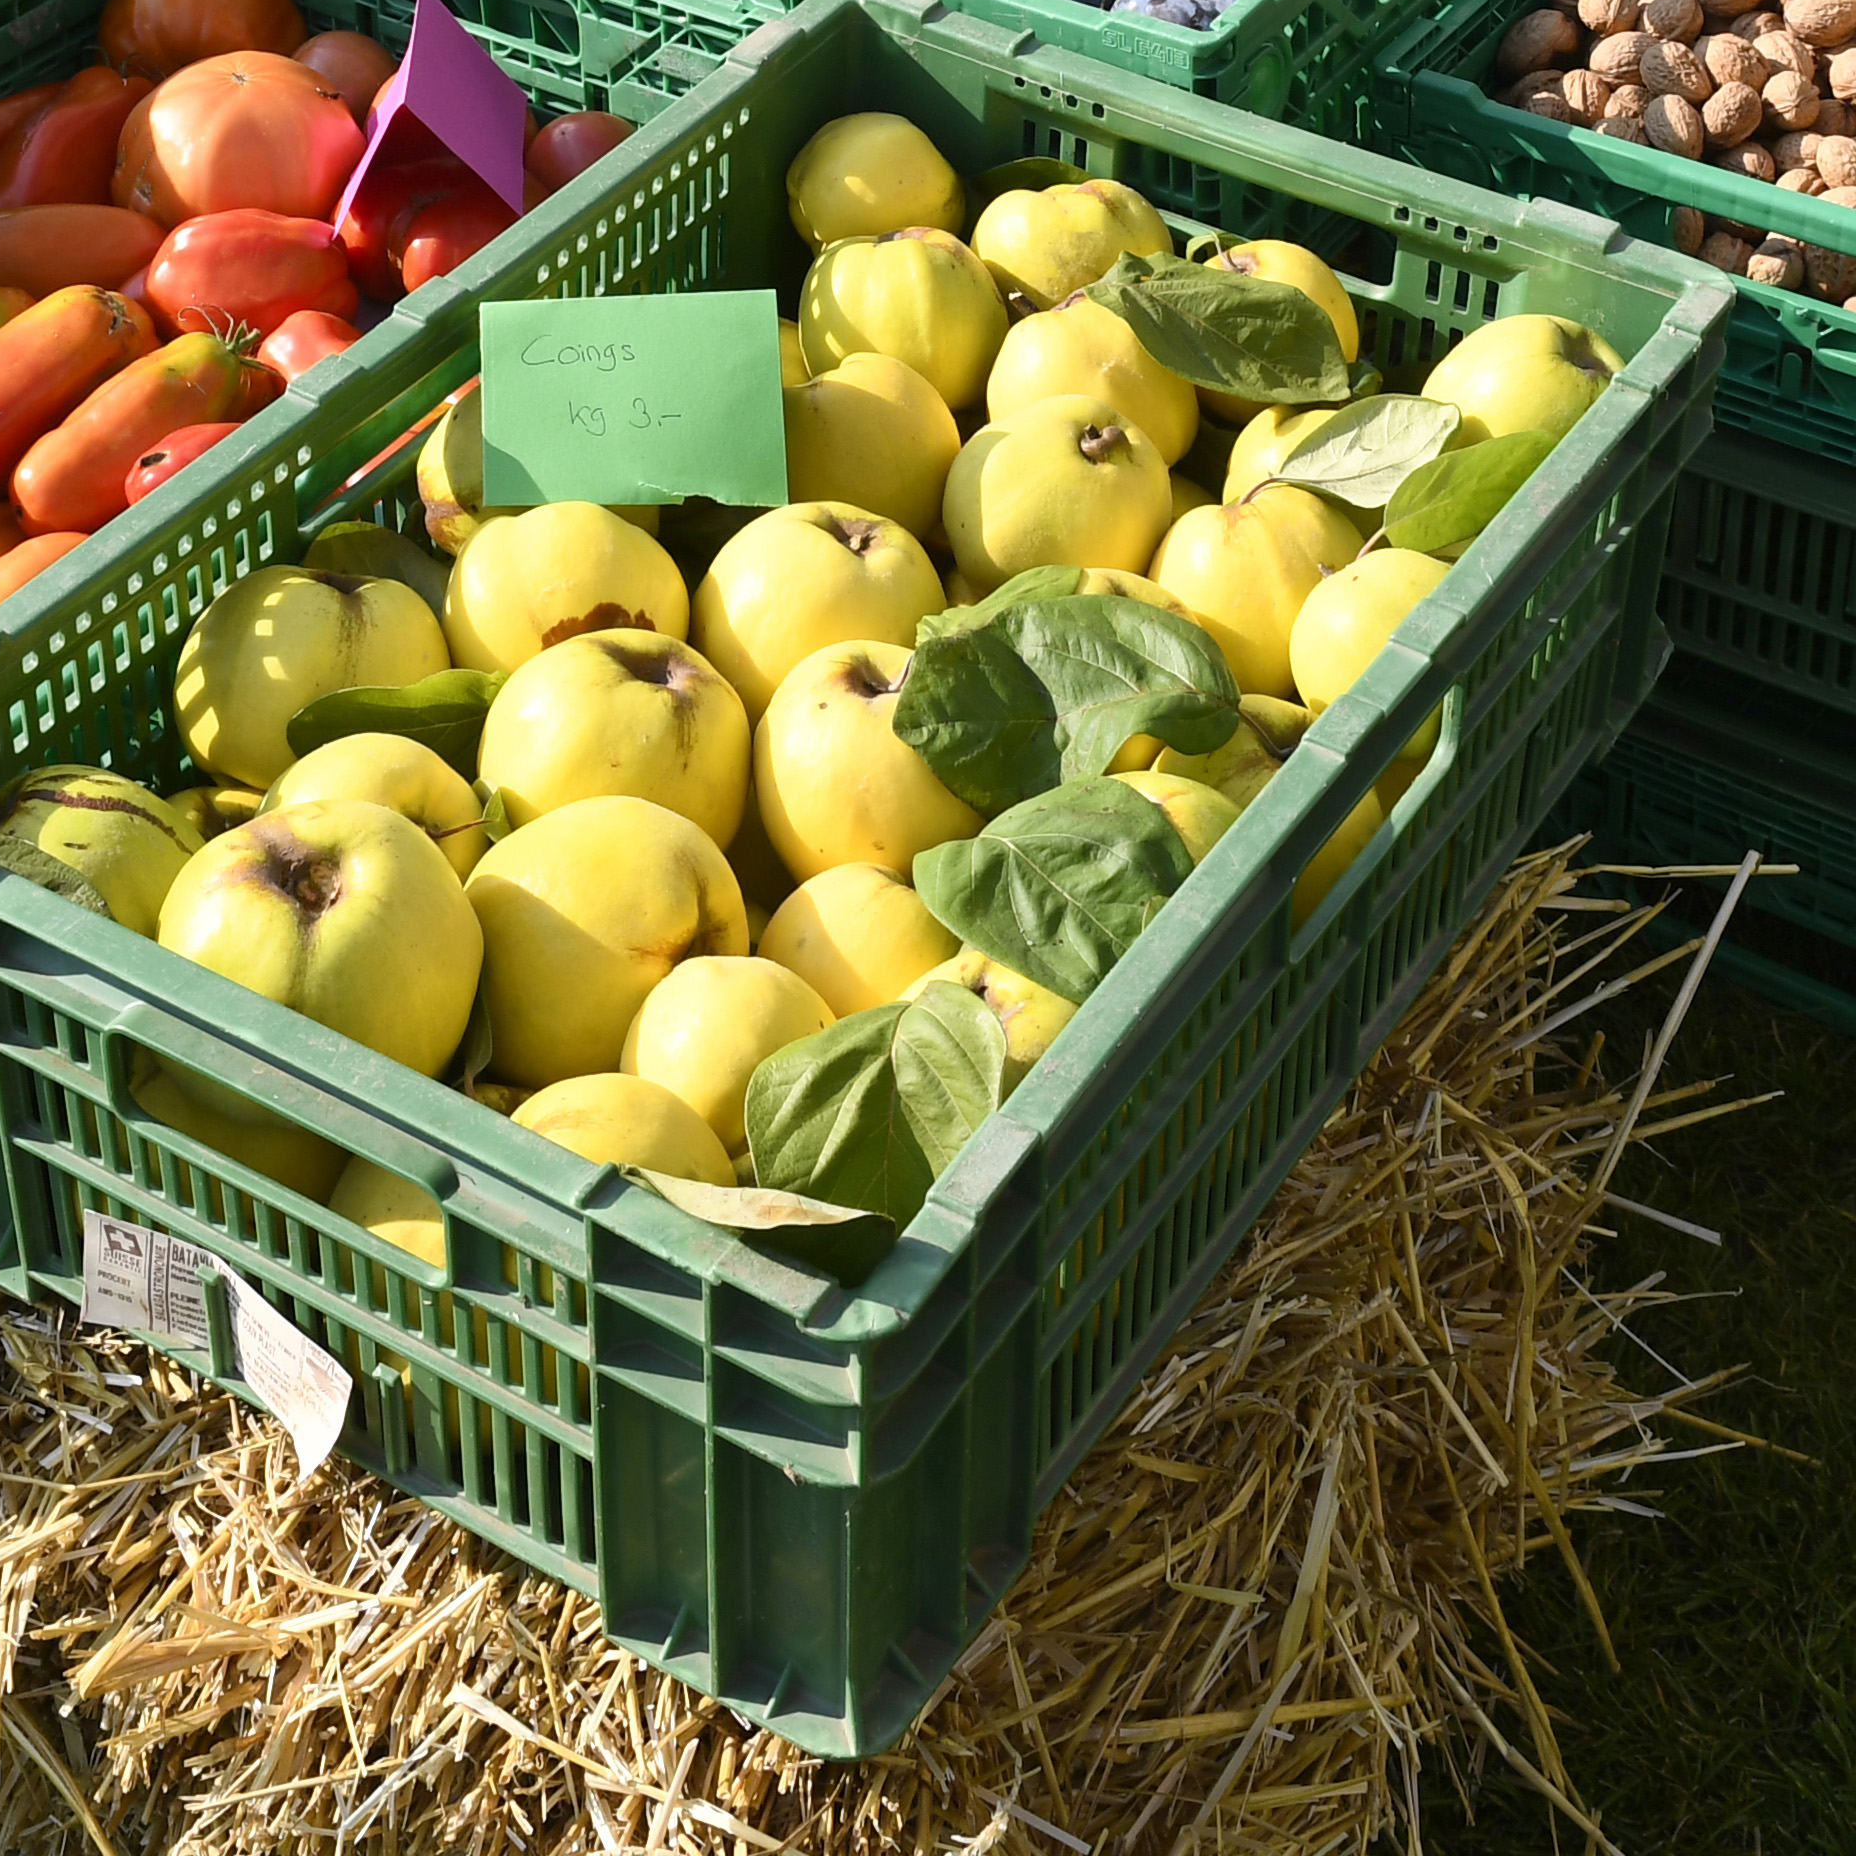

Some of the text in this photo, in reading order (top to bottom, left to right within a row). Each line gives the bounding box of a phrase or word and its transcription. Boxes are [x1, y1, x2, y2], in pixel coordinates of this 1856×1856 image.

[521, 334, 635, 371] Coings
[629, 397, 682, 428] 3.-
[104, 1248, 141, 1268] SUISSE
